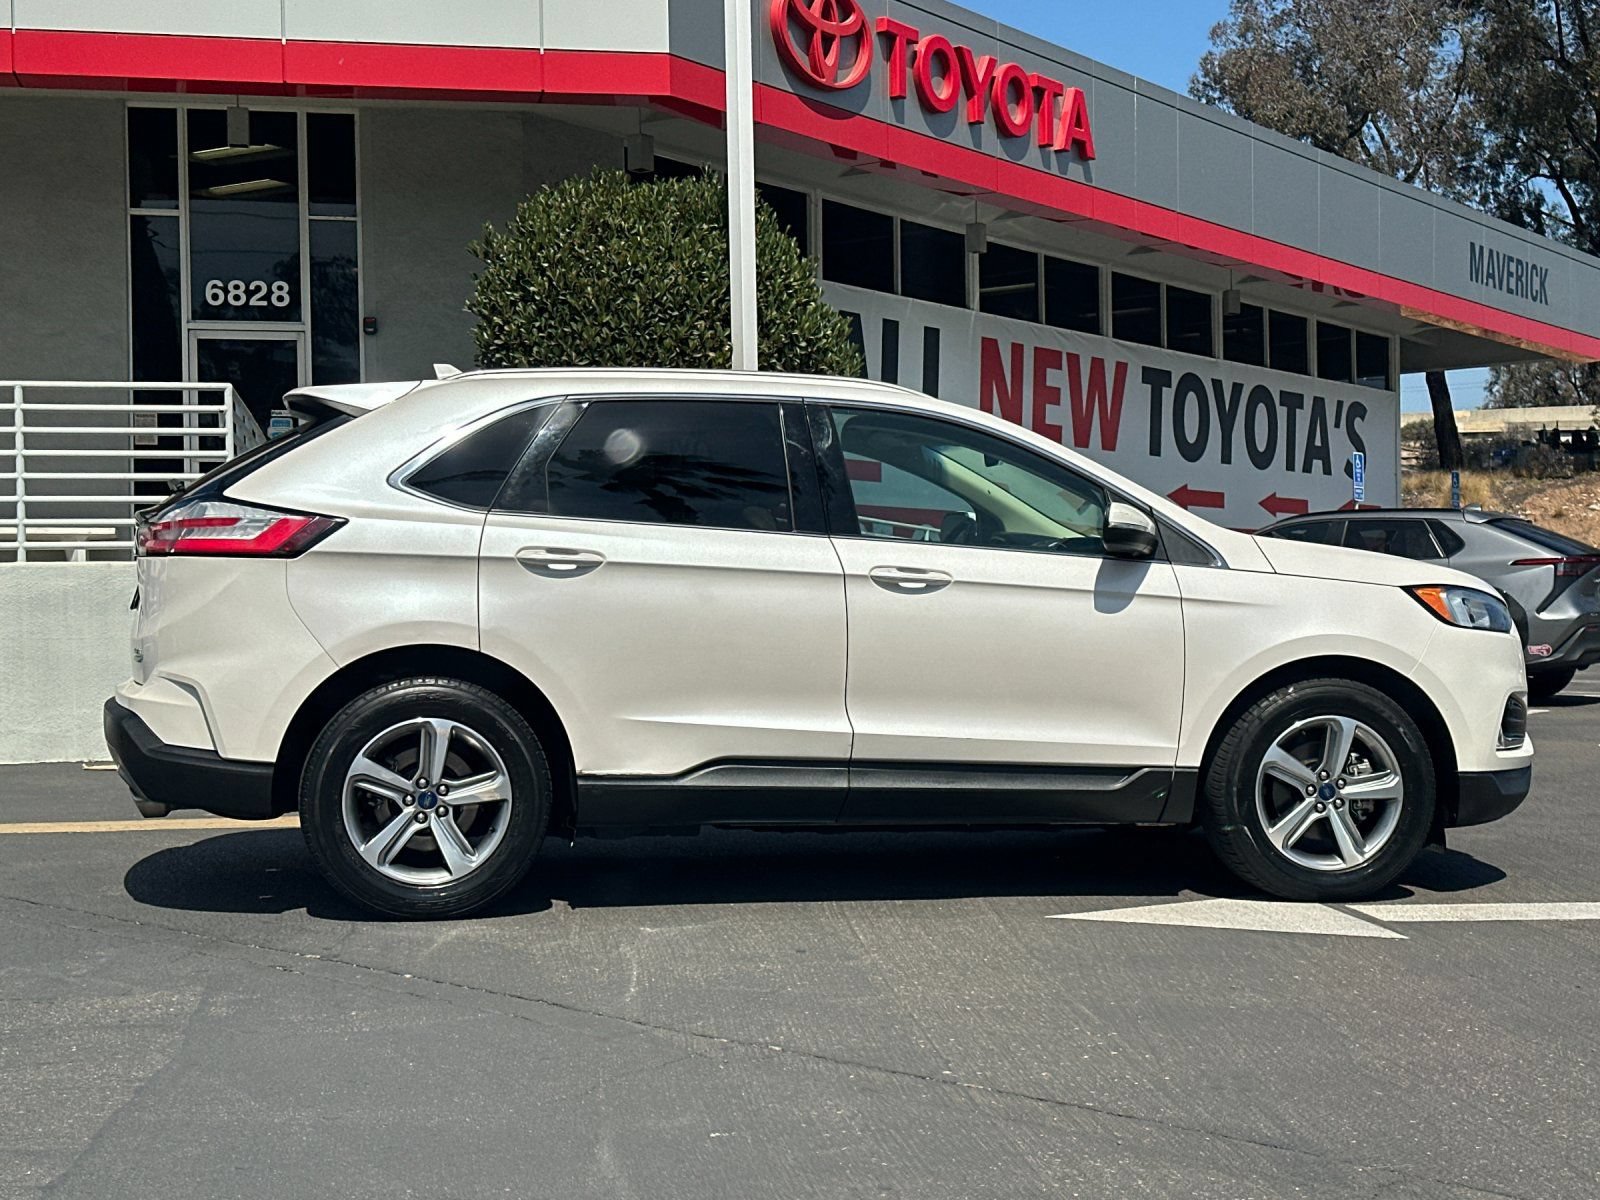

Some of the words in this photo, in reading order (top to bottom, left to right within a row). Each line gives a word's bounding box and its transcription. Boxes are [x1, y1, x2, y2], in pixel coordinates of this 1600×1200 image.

[876, 17, 1095, 160] TOYOTA
[205, 279, 290, 307] 6828
[1469, 242, 1549, 305] MAVERICK
[981, 337, 1129, 452] NEW
[1142, 365, 1368, 479] TOYOTA'S
